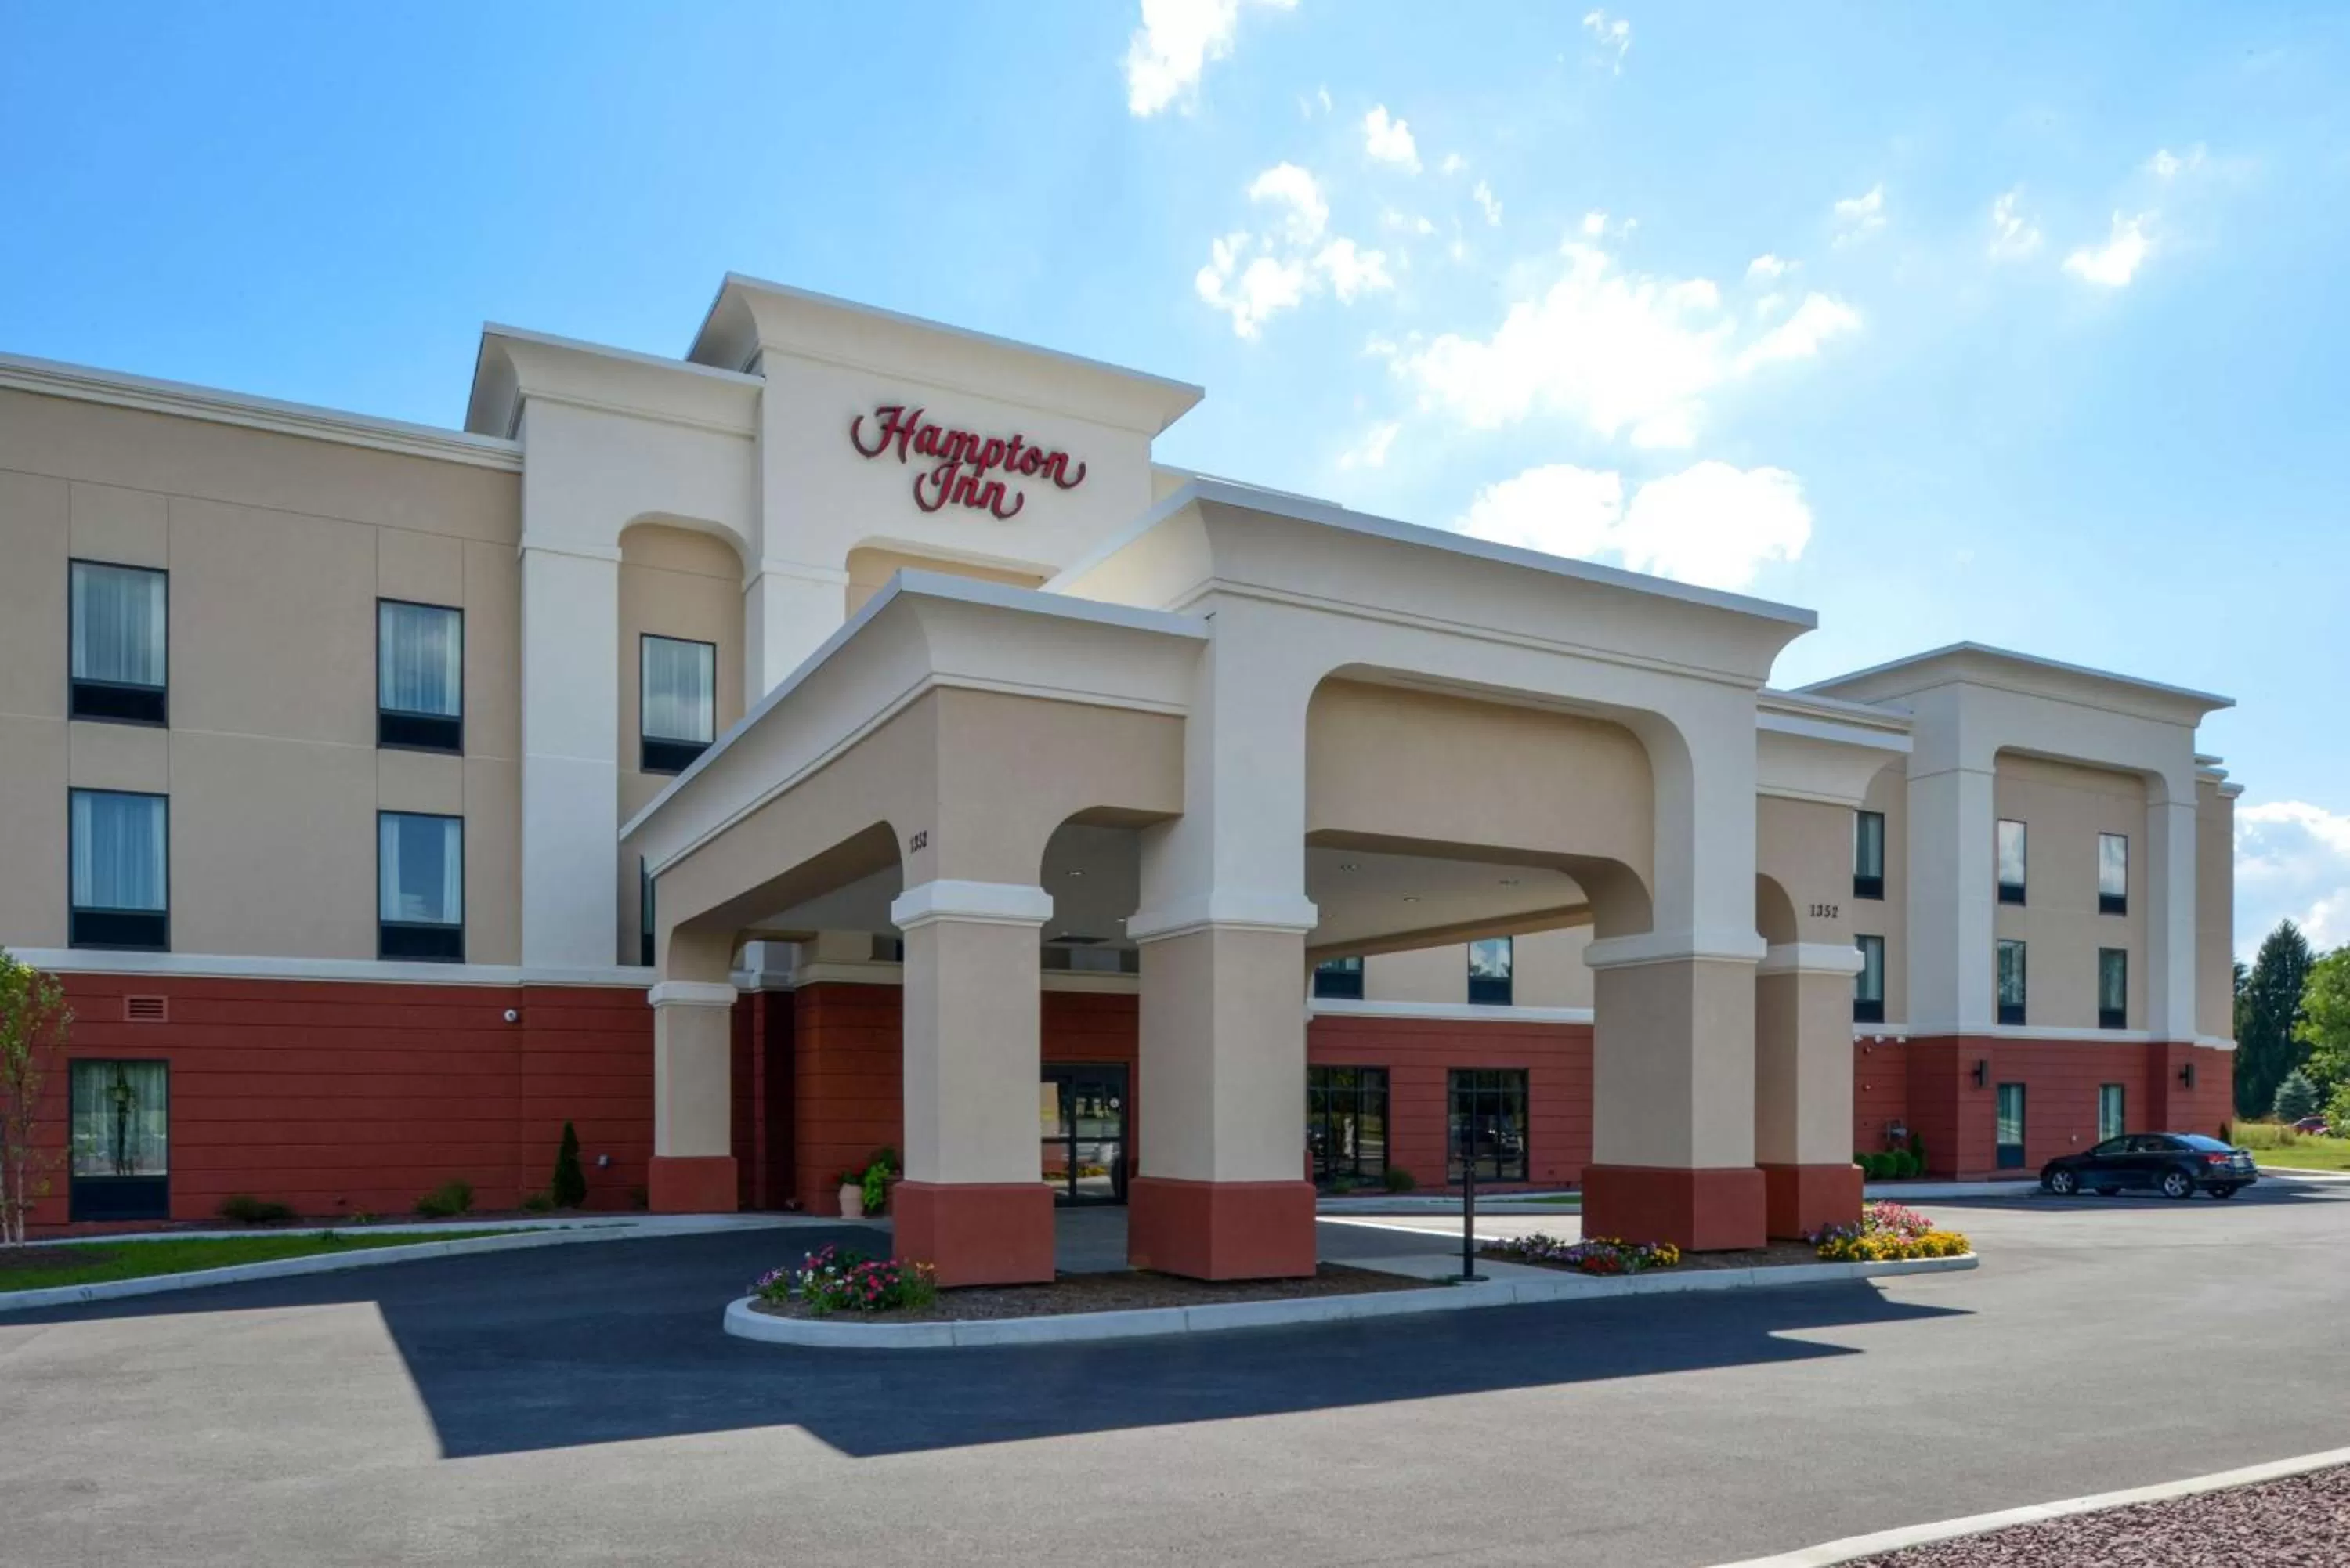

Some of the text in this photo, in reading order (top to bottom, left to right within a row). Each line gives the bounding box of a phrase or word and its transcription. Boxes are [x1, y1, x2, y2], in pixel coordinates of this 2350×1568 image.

[850, 406, 1086, 489] Hampton
[913, 461, 1025, 521] Inn
[1810, 904, 1838, 919] 1352
